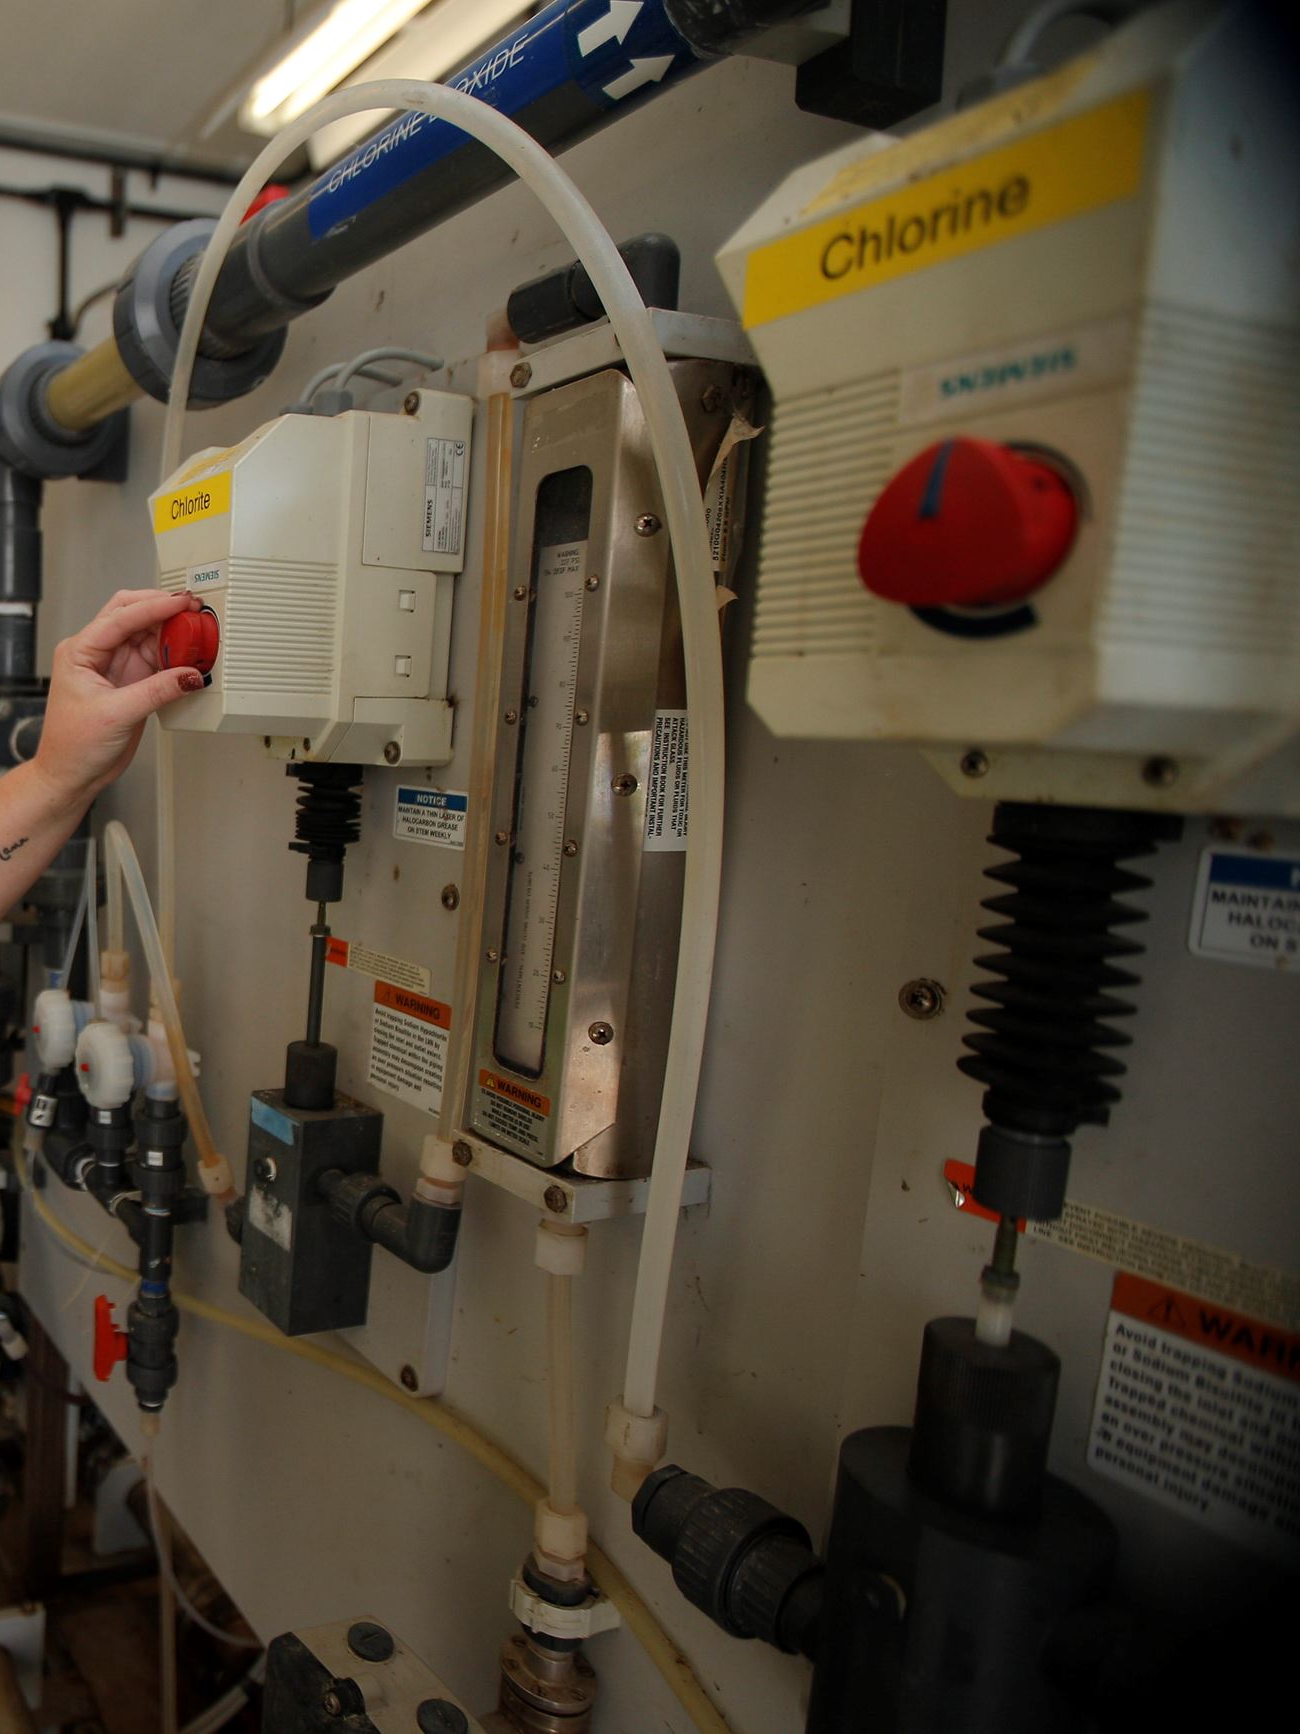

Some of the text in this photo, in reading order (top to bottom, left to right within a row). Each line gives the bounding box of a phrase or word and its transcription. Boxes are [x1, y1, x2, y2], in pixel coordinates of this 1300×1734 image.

[328, 111, 423, 193] CHLORINE
[819, 175, 1031, 281] Chlorine
[171, 491, 211, 520] Chlorite
[425, 499, 433, 537] SIEMENS
[194, 569, 220, 583] SIEMENS
[653, 717, 663, 761] PRECAUTIONS
[661, 733, 670, 774] INSTRUCTION
[677, 718, 685, 756] HAZARDOUS
[416, 794, 447, 806] NOTICE
[649, 777, 658, 814] IMPORTANT
[659, 775, 667, 793] BOOK
[673, 791, 681, 813] FLUIDS
[675, 781, 681, 790] OR
[398, 806, 421, 814] MAINTAIN
[426, 810, 438, 818] THIN
[402, 816, 458, 831] HALOCARBON GREASE
[656, 809, 664, 837] FURTHER
[670, 815, 678, 831] THAT
[430, 830, 452, 839] WEEKLY
[676, 828, 683, 838] OR
[395, 992, 441, 1020] WARNING
[497, 1079, 541, 1108] WARNING
[1113, 1343, 1127, 1357] or
[1133, 1348, 1190, 1382] Sodium
[1116, 1323, 1157, 1349] Avoid
[1162, 1341, 1227, 1381] trapping
[1109, 1375, 1166, 1410] Trapped
[1170, 1405, 1244, 1446] chemical
[1110, 1359, 1163, 1392] closing
[1168, 1384, 1192, 1401] the
[1198, 1397, 1233, 1421] inlet
[1239, 1416, 1271, 1438] and
[1104, 1395, 1212, 1455] assembly may
[1101, 1412, 1118, 1426] an
[1123, 1422, 1156, 1444] over
[1160, 1439, 1229, 1479] pressure
[1116, 1438, 1196, 1483] equipment
[1096, 1446, 1159, 1484] personal
[1164, 1479, 1208, 1511] injury
